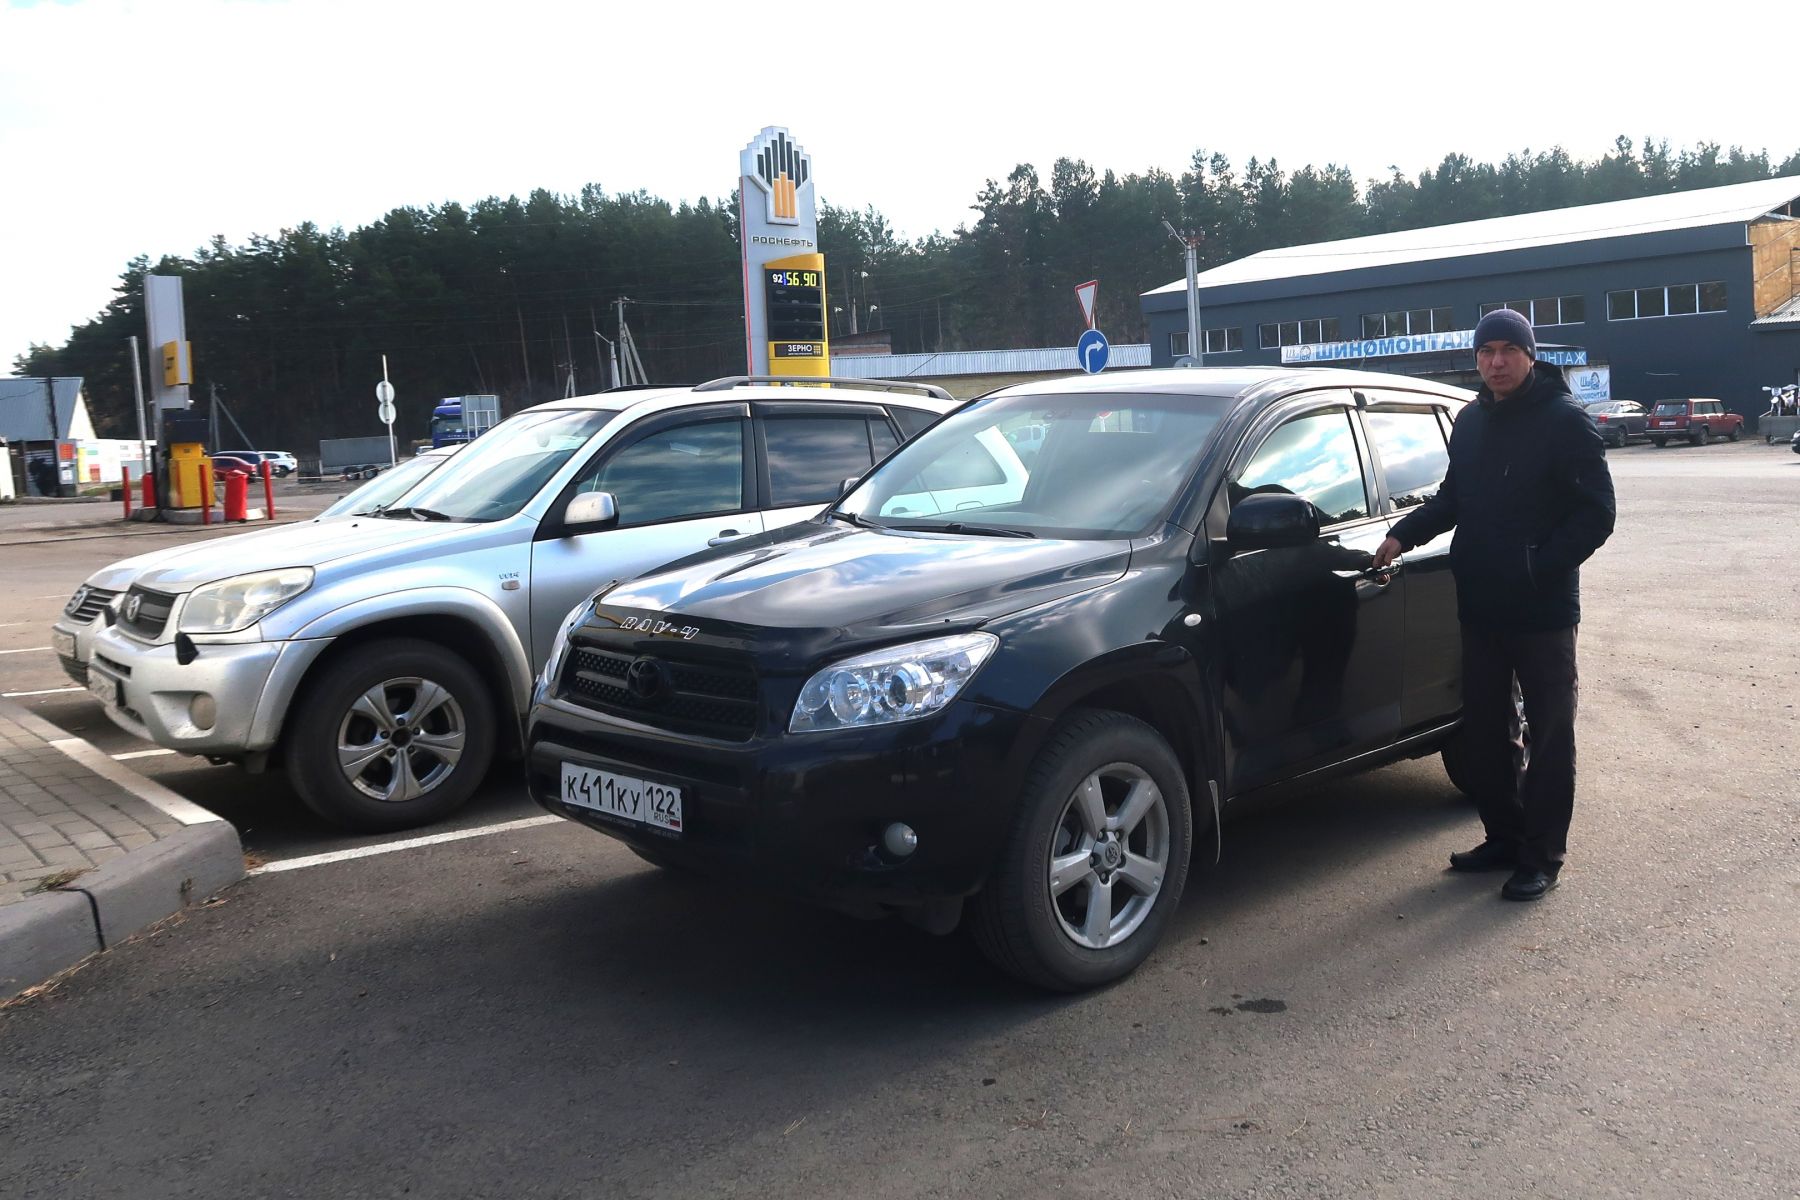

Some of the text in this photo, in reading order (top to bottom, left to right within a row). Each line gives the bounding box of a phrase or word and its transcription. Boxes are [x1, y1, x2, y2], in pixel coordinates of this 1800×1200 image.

[752, 236, 813, 247] РОСНЕФТЬ
[772, 272, 817, 287] 92 56.90
[787, 344, 813, 352] ЗЕРНО
[619, 616, 699, 640] RAV-4
[567, 772, 676, 816] К411КУ 122
[653, 811, 670, 824] RUS
